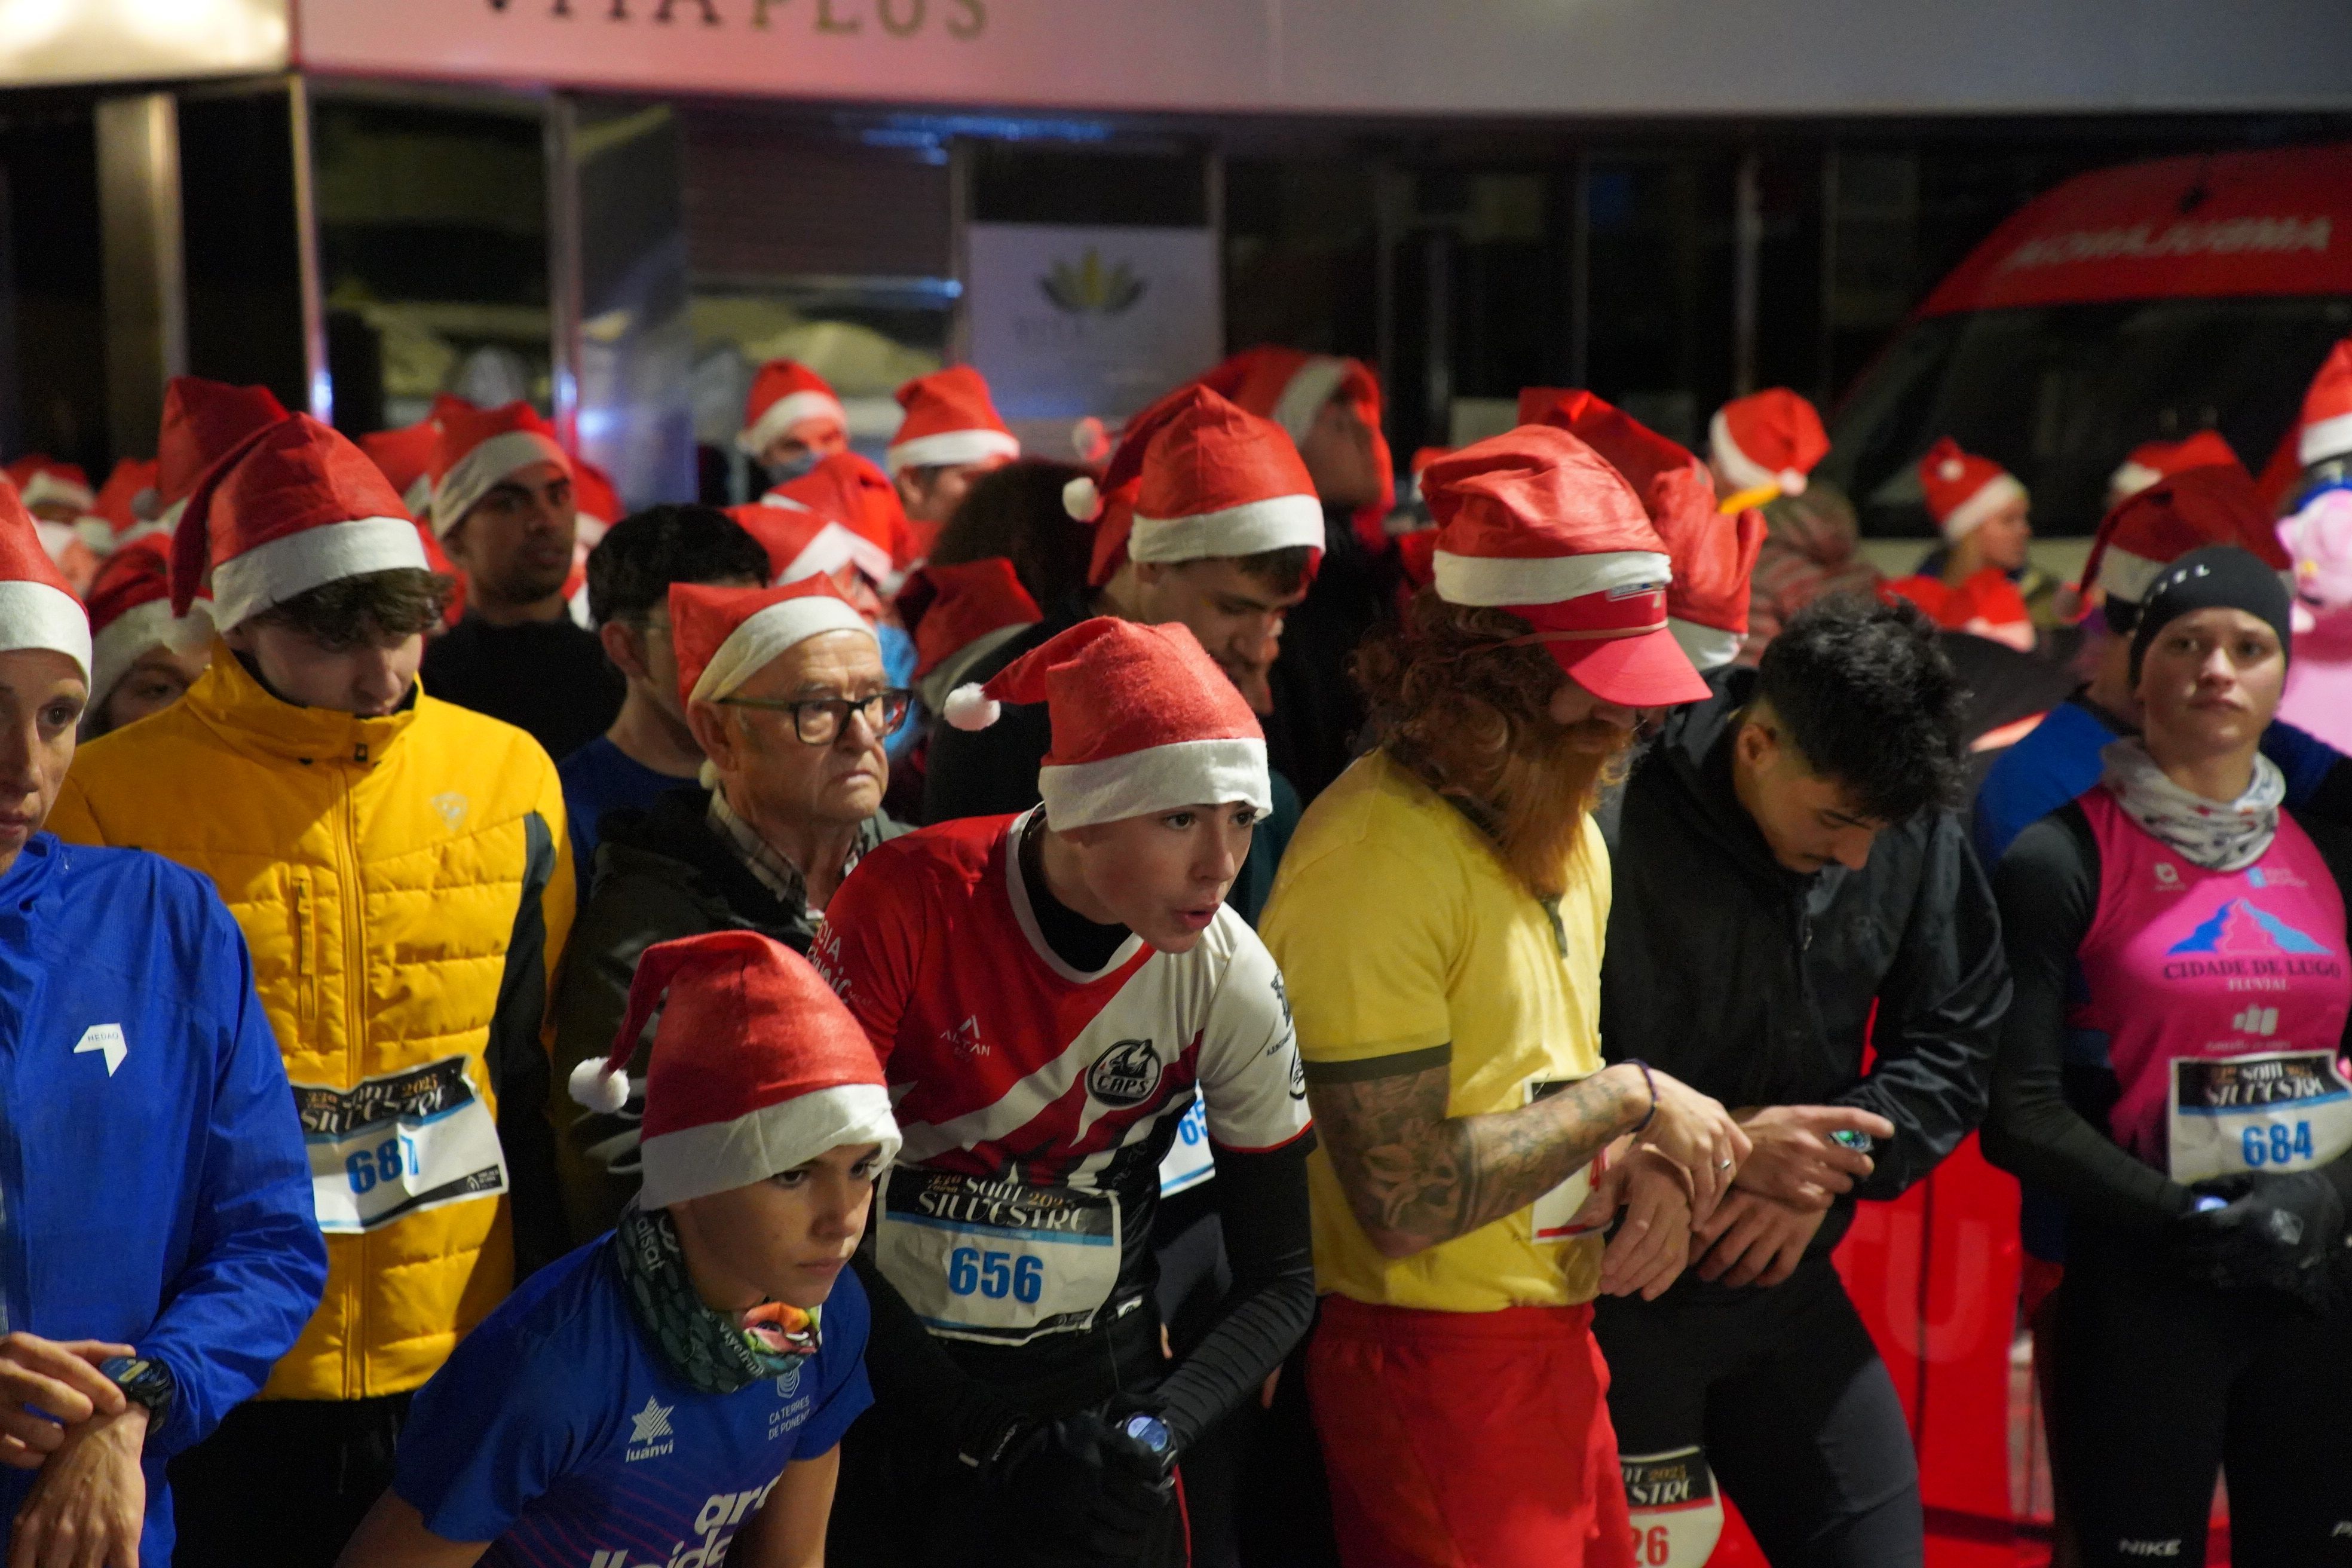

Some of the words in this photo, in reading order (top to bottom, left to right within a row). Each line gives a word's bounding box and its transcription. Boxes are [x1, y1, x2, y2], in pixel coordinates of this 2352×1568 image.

[2163, 960, 2244, 978] CIDADE
[2251, 959, 2282, 975] DE
[1097, 1075, 1150, 1095] CAPS
[2243, 1120, 2314, 1167] 684
[949, 1247, 1043, 1304] 656
[625, 1438, 673, 1463] luanvi
[2119, 1539, 2182, 1556] NIKE
